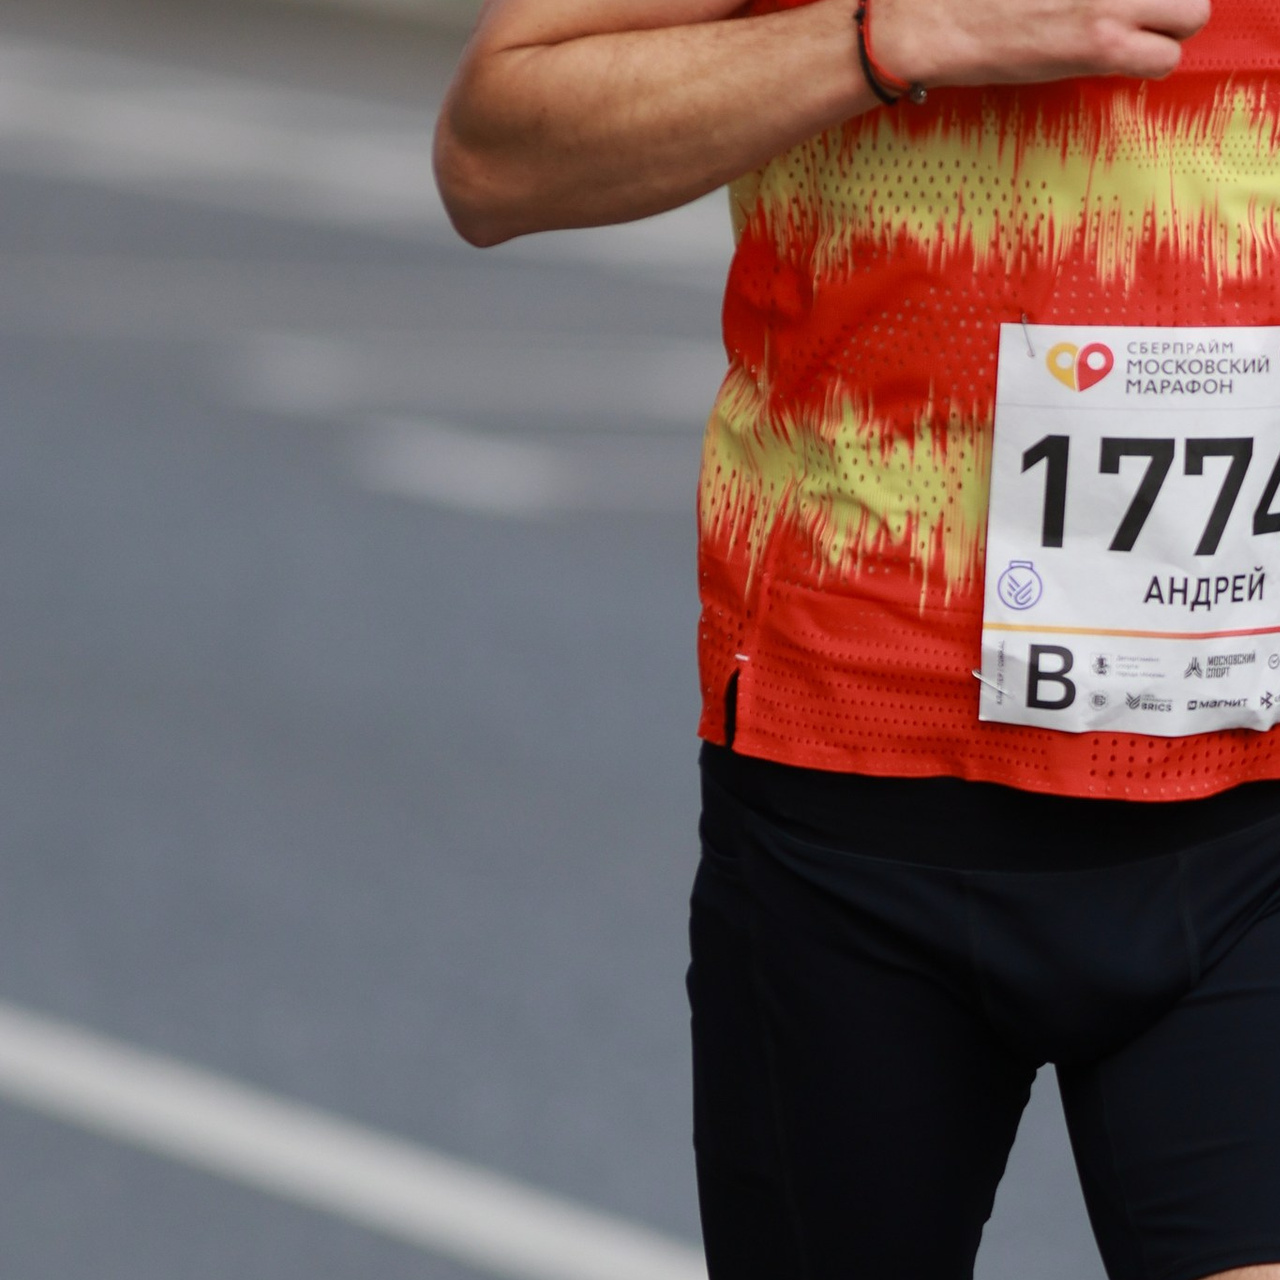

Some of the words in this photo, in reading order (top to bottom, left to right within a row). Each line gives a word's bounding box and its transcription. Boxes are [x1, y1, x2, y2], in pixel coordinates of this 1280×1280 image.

[1126, 340, 1234, 355] СБЕРПРАЙМ
[1126, 354, 1270, 375] МОСКОВСКИЙ
[1125, 378, 1234, 395] МАРАФОН
[1143, 566, 1266, 612] АНДРЕЙ
[1208, 651, 1256, 666] МОСКОВСКИЙ
[1026, 644, 1076, 710] B
[1206, 667, 1231, 678] СПОРТ
[1141, 702, 1172, 712] BRICS
